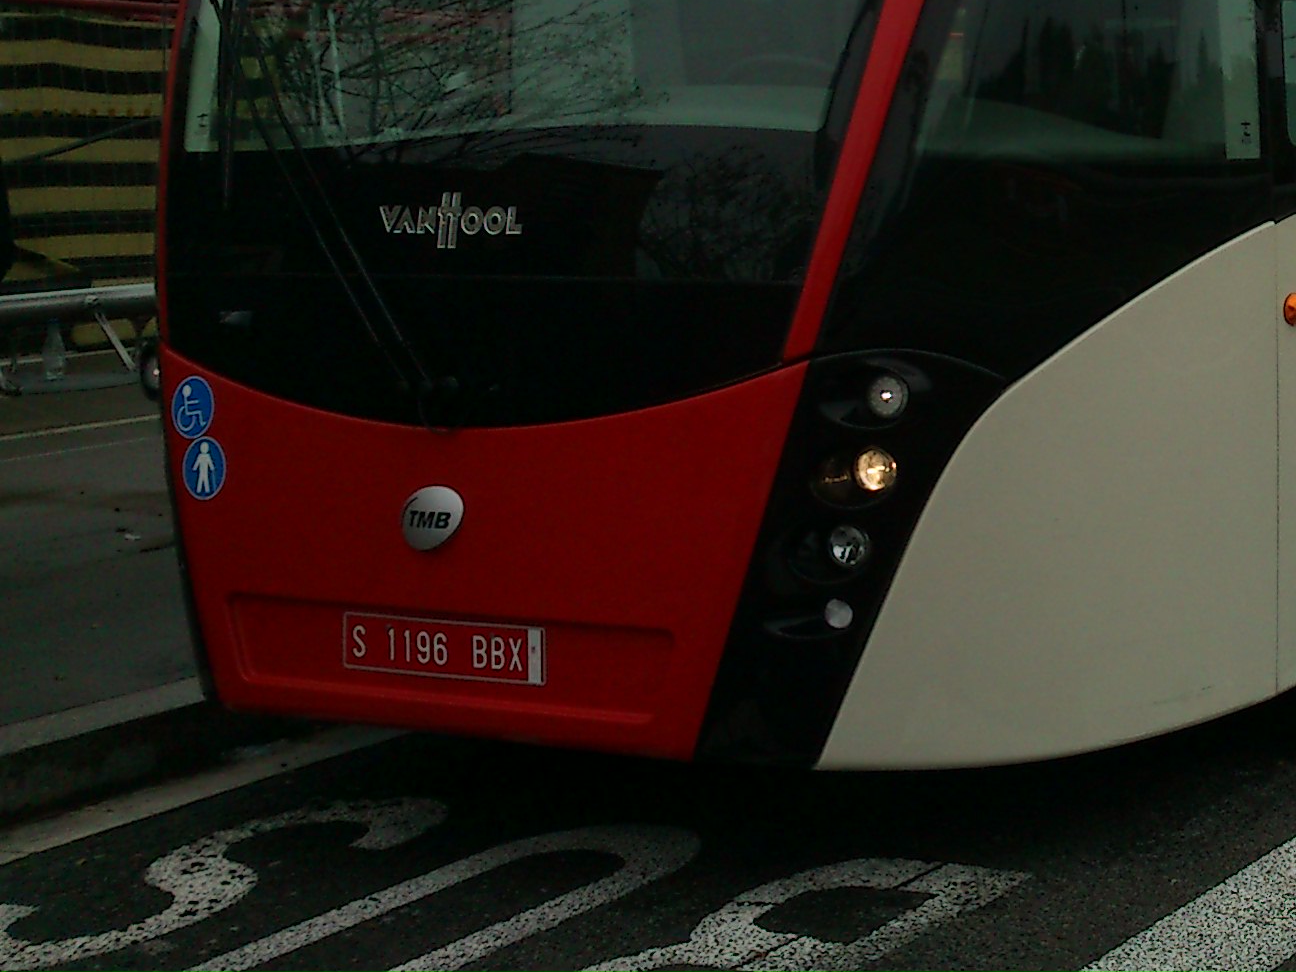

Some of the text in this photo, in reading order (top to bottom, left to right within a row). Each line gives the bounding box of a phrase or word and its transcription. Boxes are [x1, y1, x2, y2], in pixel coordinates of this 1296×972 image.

[409, 511, 452, 529] TMB
[352, 625, 523, 672] S 1196 BBX
